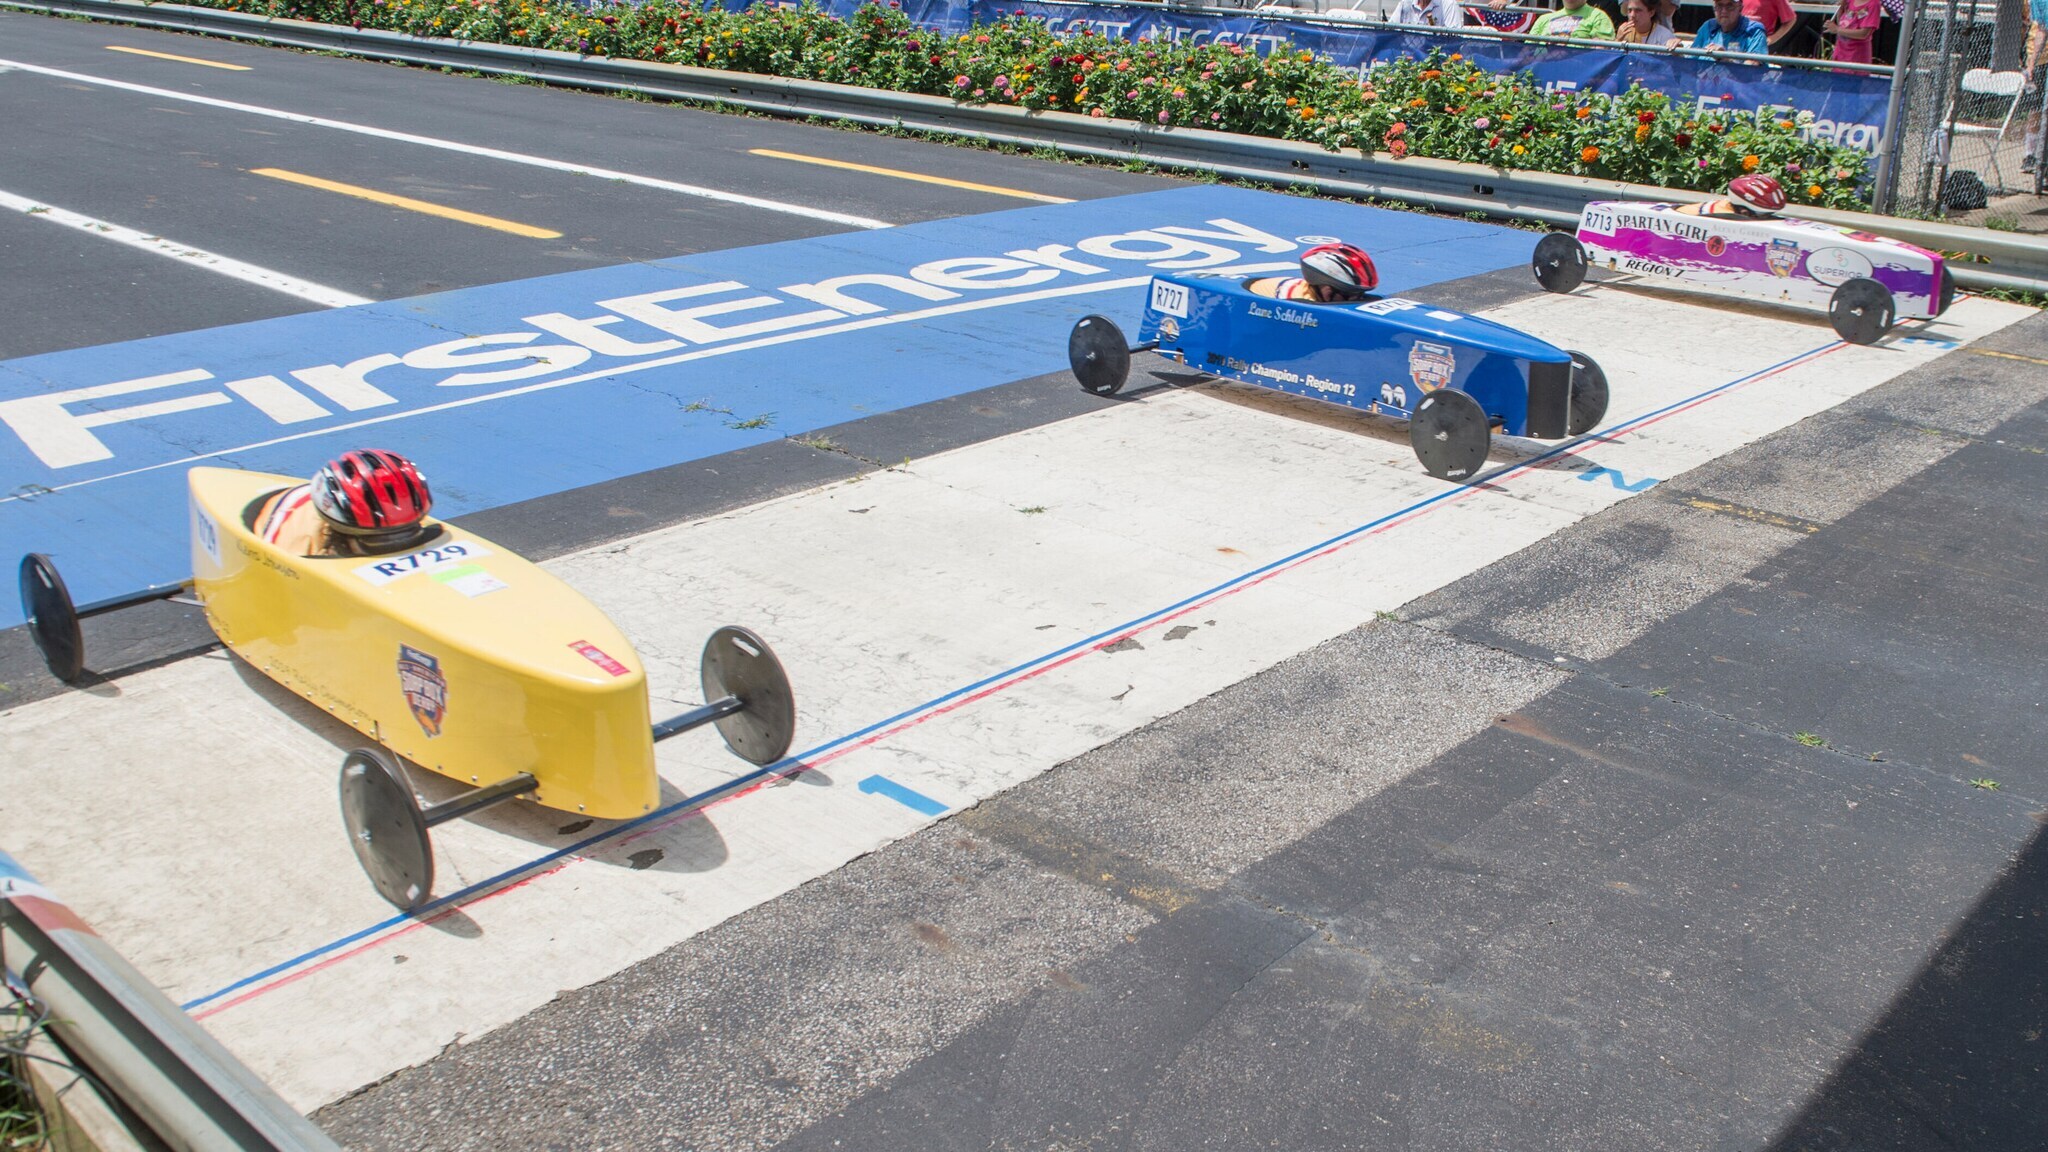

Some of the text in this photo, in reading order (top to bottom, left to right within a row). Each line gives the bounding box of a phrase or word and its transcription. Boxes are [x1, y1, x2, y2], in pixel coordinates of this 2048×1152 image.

[1585, 212, 1612, 231] R713
[1616, 214, 1709, 242] SPARTAN GIRL
[1626, 259, 1674, 276] REGION
[1157, 286, 1183, 311] R727
[0, 218, 1299, 469] FirstEnergy
[1227, 356, 1250, 375] Rally
[1250, 362, 1299, 384] Champion
[1305, 374, 1342, 393] Region
[1343, 383, 1356, 397] 12
[1577, 467, 1663, 492] 2
[373, 545, 468, 577] R729
[858, 774, 950, 816] 1
